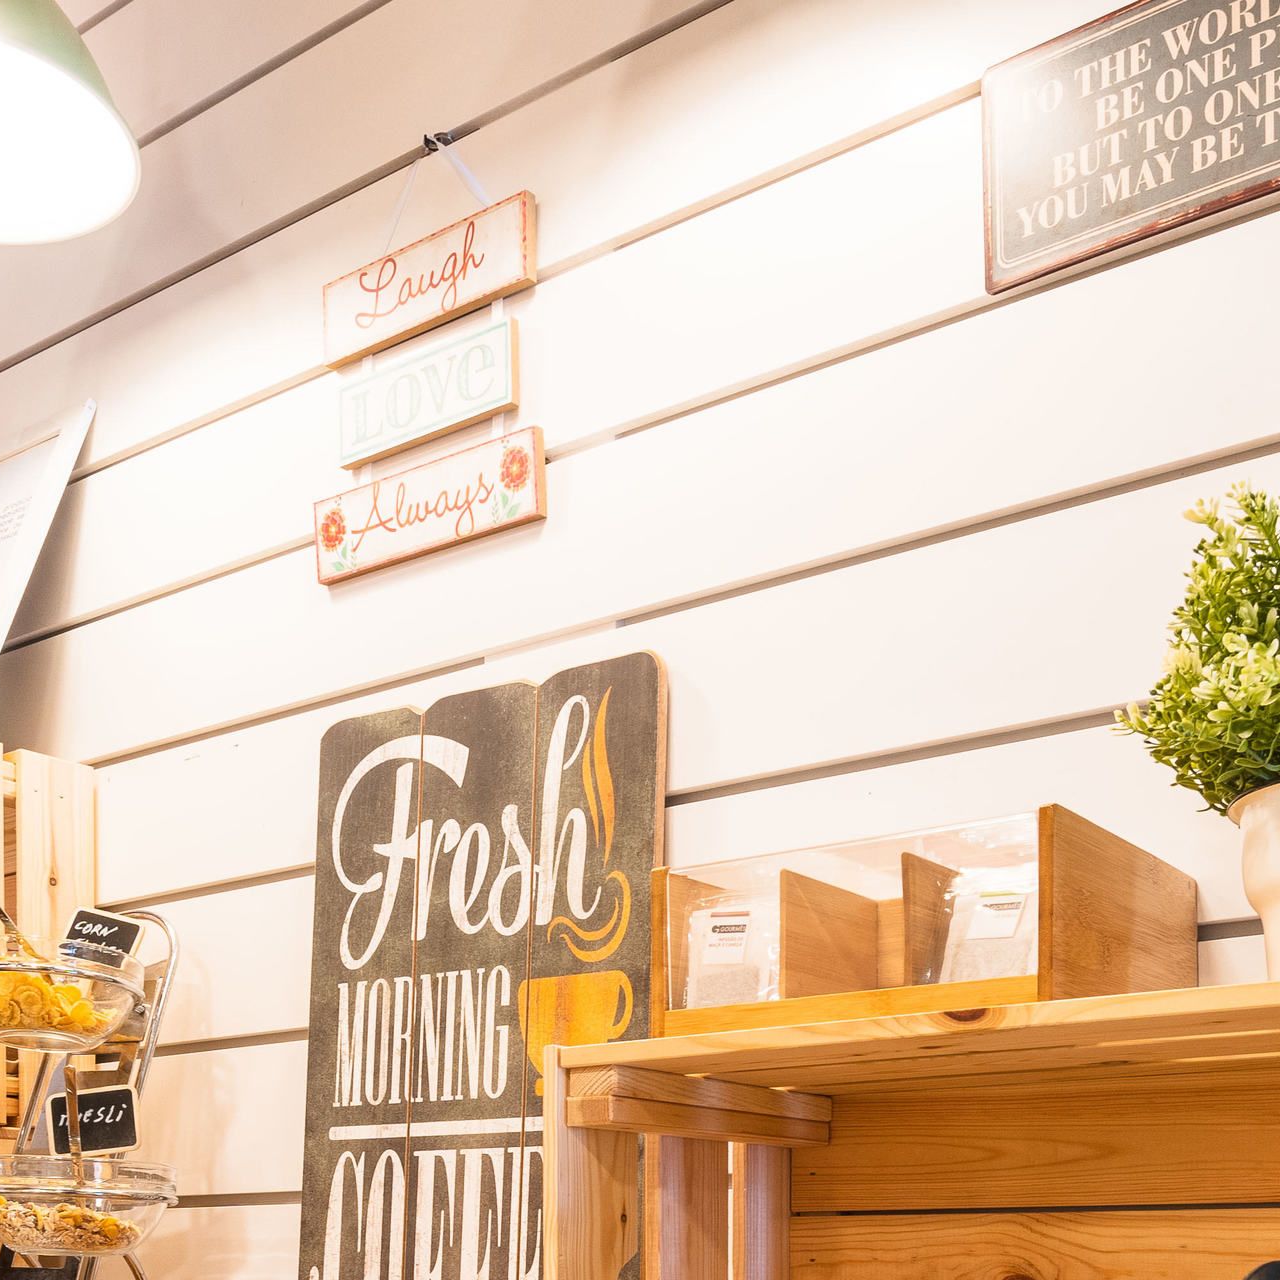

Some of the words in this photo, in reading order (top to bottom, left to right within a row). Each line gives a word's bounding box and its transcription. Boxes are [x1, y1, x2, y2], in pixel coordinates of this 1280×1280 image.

[1022, 78, 1063, 121] TO
[1074, 38, 1152, 99] THE
[1095, 81, 1145, 132] BE
[1155, 43, 1237, 104] ONE
[1017, 183, 1088, 239] YOU
[1100, 147, 1178, 207] MAY
[1191, 124, 1245, 174] BE
[1052, 130, 1127, 189] BUT
[1138, 106, 1193, 152] TO
[354, 221, 485, 329] Laugh
[350, 472, 495, 552] Always
[332, 695, 602, 970] Fresh
[74, 921, 119, 937] CORN
[333, 965, 511, 1108] MORNING
